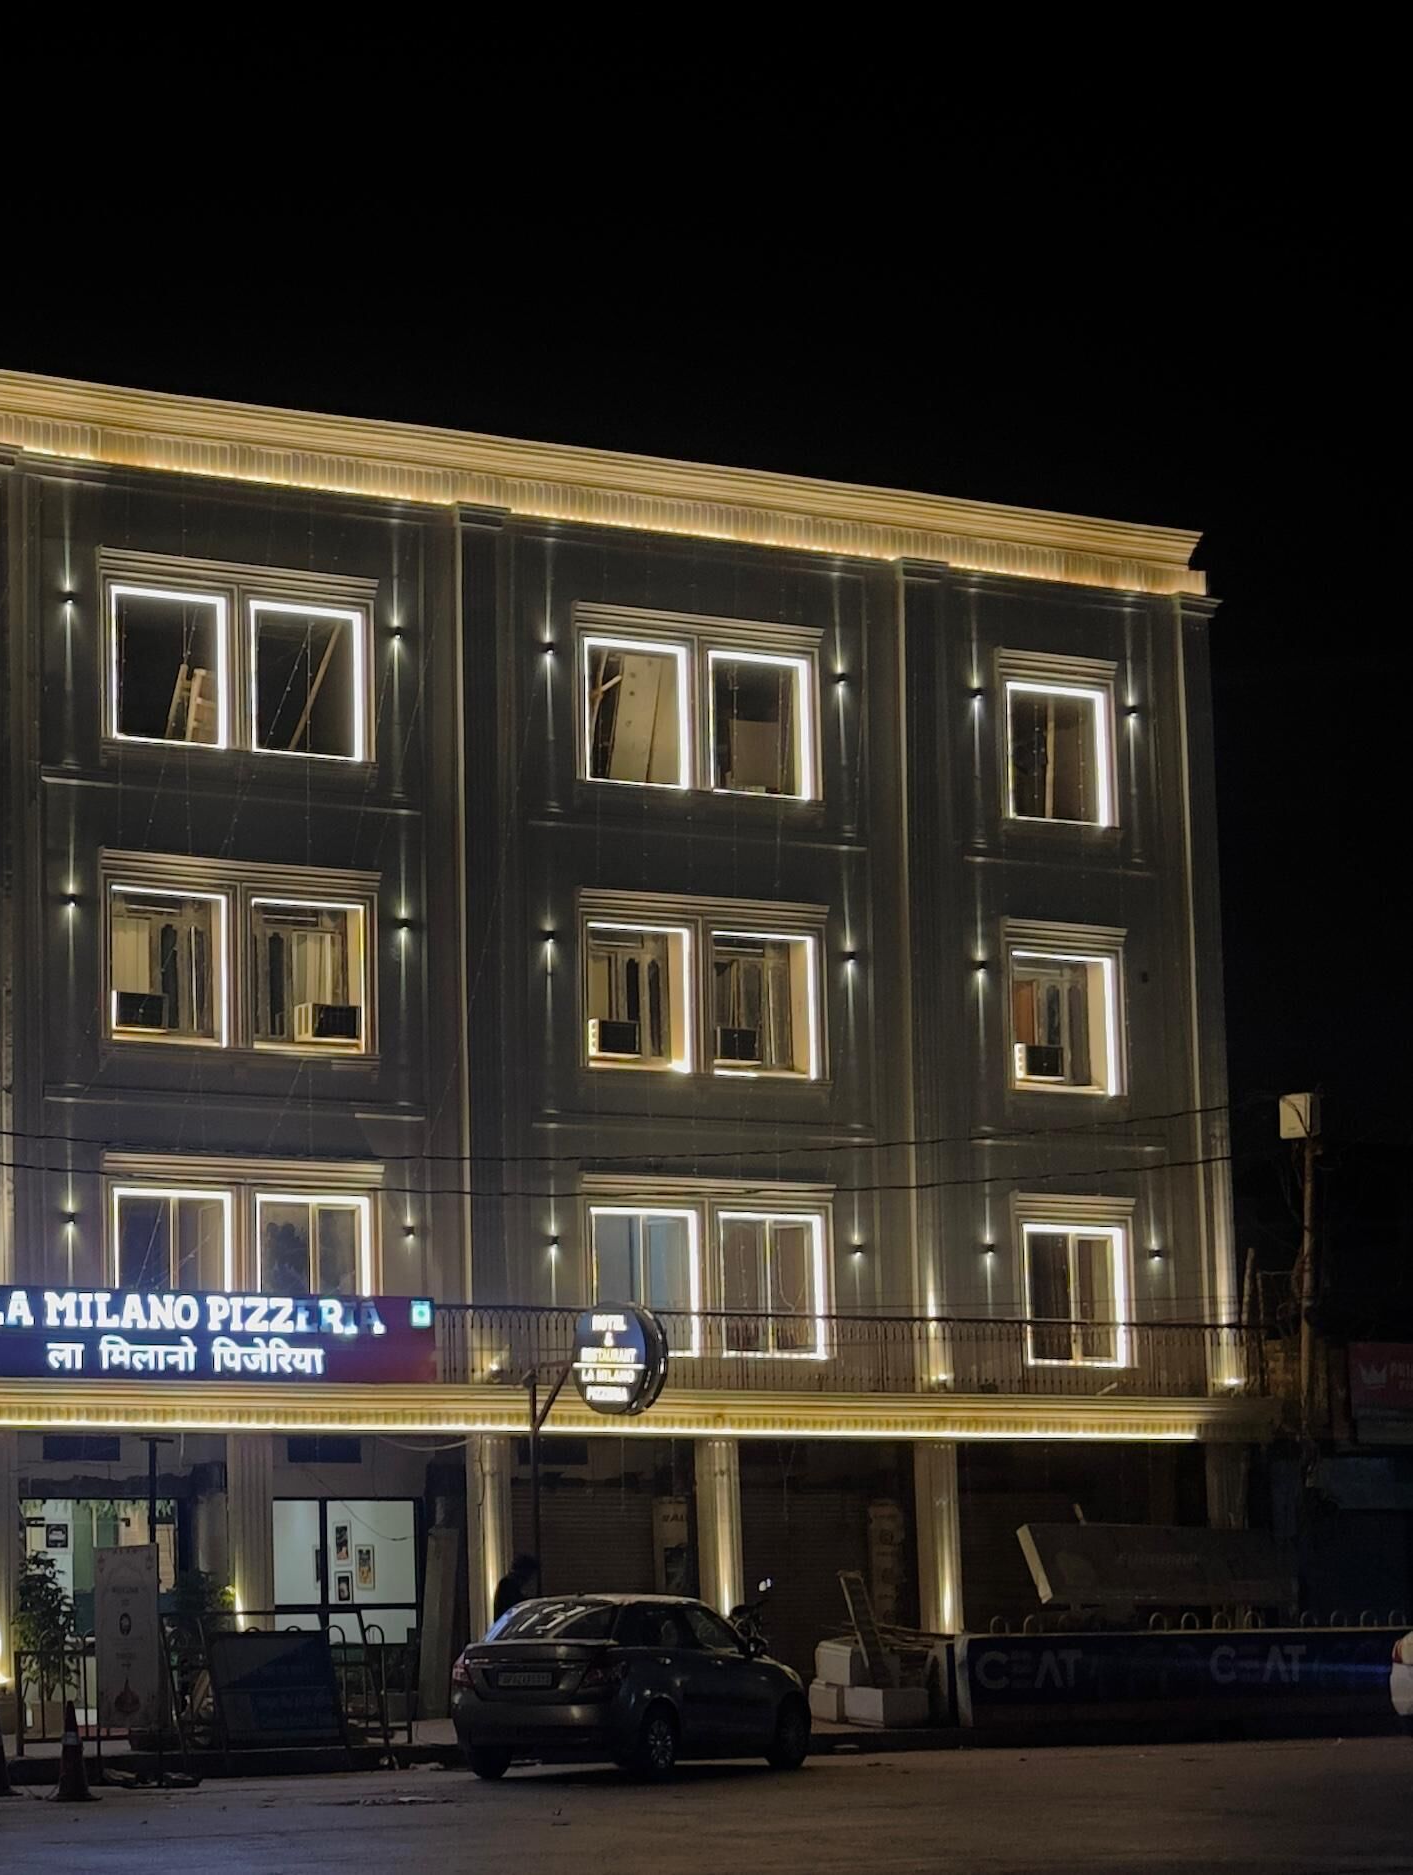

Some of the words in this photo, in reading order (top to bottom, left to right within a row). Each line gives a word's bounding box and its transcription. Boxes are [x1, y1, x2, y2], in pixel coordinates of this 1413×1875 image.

[43, 1291, 199, 1331] MILANO
[205, 1296, 386, 1335] PIZZERIA
[46, 1341, 85, 1369] ला
[99, 1335, 197, 1372] मिलानो
[211, 1337, 326, 1375] पिजेरिया
[975, 1648, 1083, 1689] CEAT
[1208, 1643, 1307, 1683] CEAT
